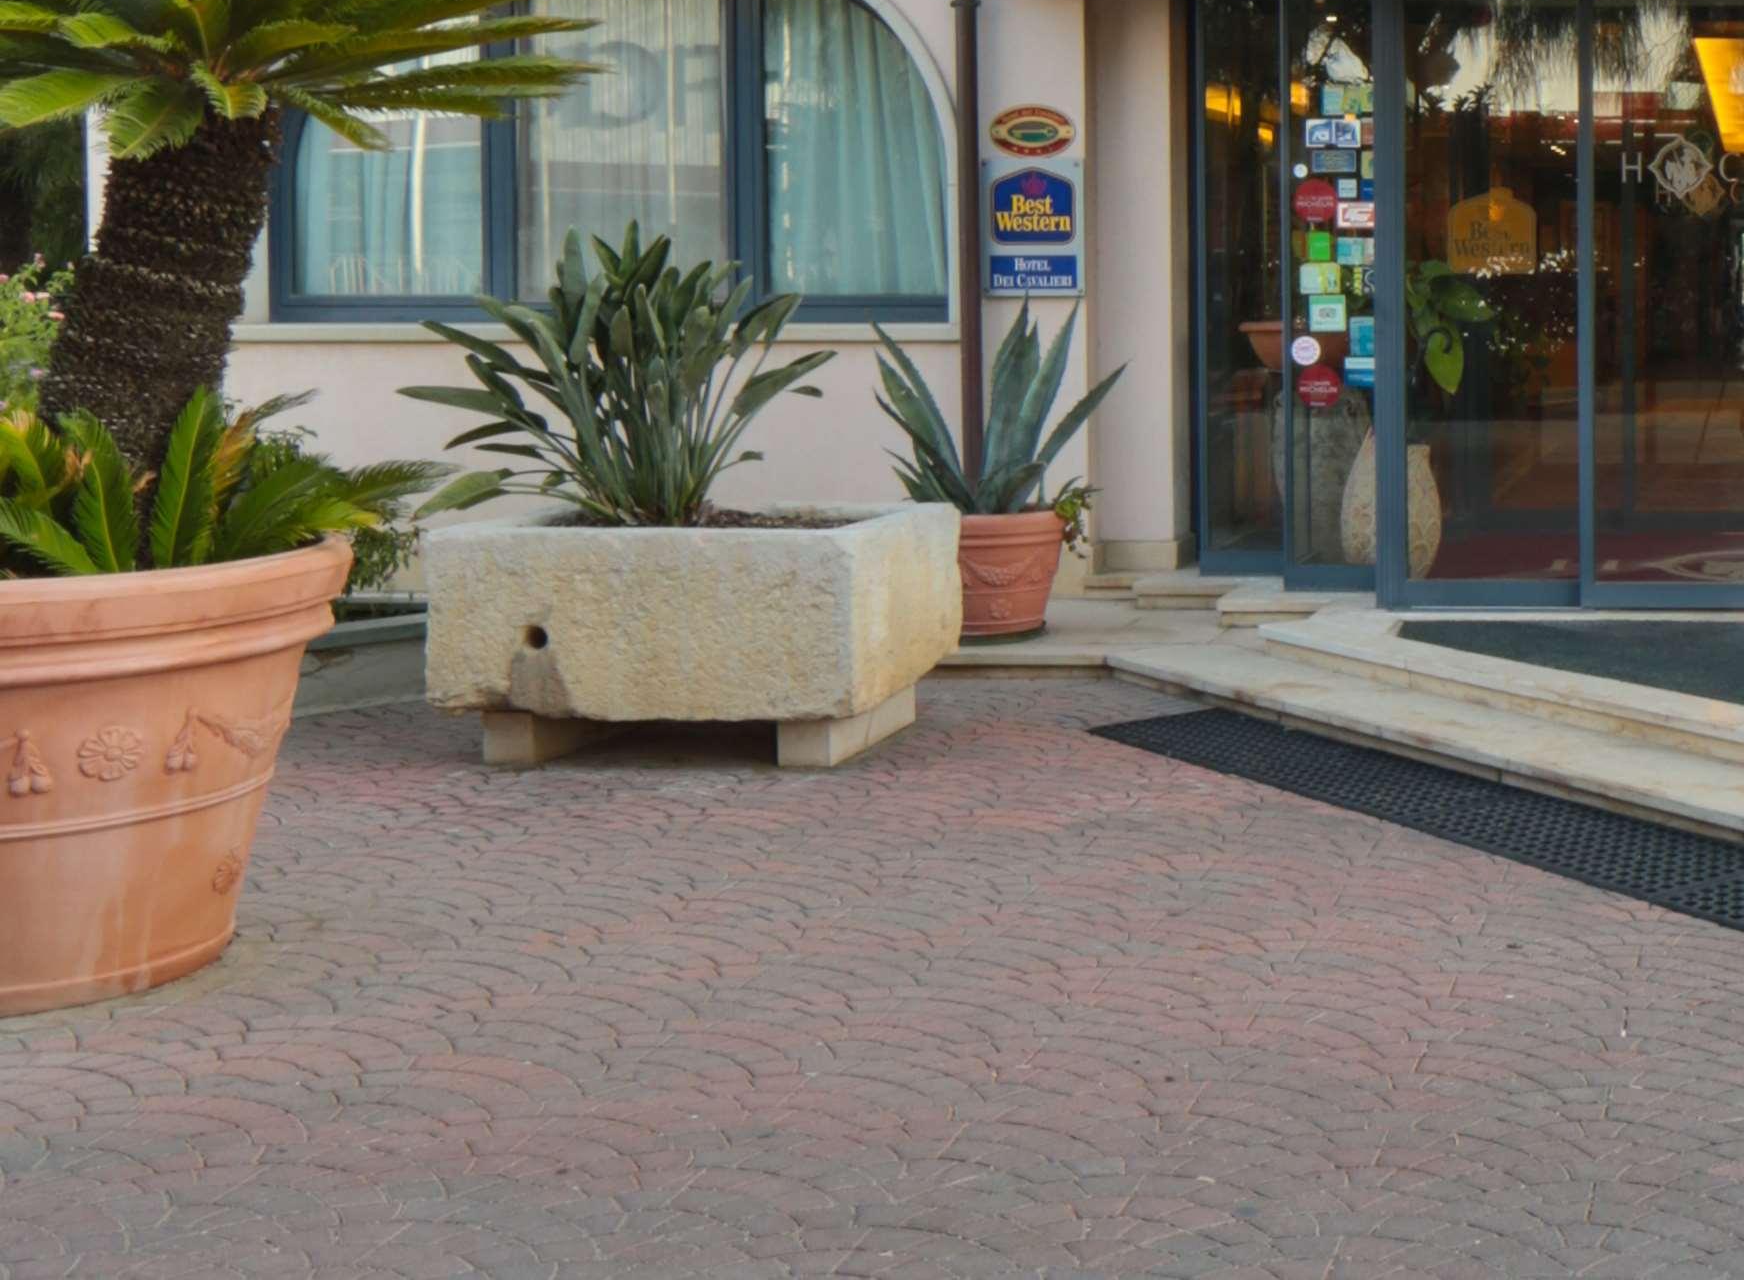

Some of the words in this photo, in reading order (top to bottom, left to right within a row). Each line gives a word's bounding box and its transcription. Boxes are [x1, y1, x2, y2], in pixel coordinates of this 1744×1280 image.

[1010, 193, 1054, 215] Best
[995, 210, 1072, 232] Western
[1014, 257, 1051, 272] HOTEL
[993, 273, 1014, 288] DEI
